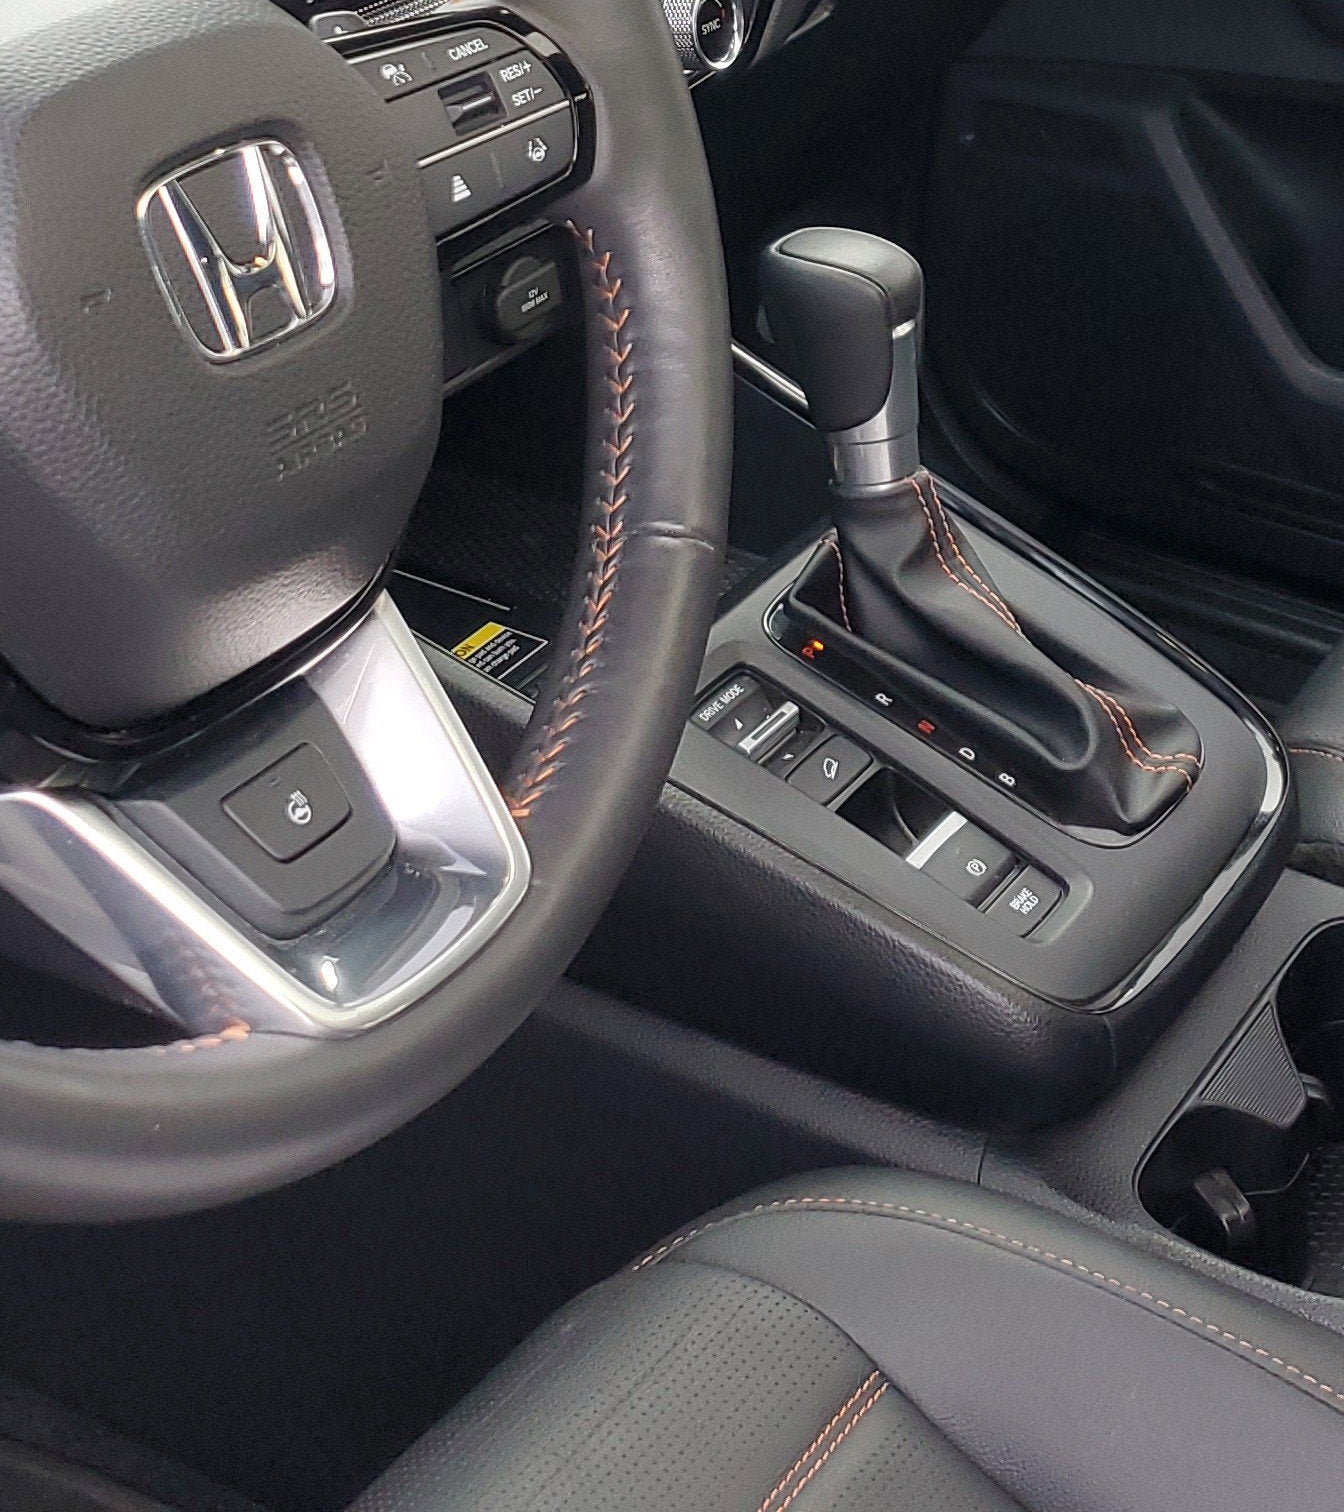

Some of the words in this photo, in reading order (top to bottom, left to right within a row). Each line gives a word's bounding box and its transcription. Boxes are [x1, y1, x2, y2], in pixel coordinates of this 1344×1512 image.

[701, 18, 721, 35] SYNC
[448, 38, 489, 61] CANCEL
[698, 701, 724, 722] DRIVE
[719, 684, 745, 704] MODE
[874, 693, 893, 707] R
[958, 747, 976, 761] D
[998, 772, 1016, 788] B
[1009, 887, 1033, 910] BRAKE
[1019, 895, 1040, 915] HOLD
